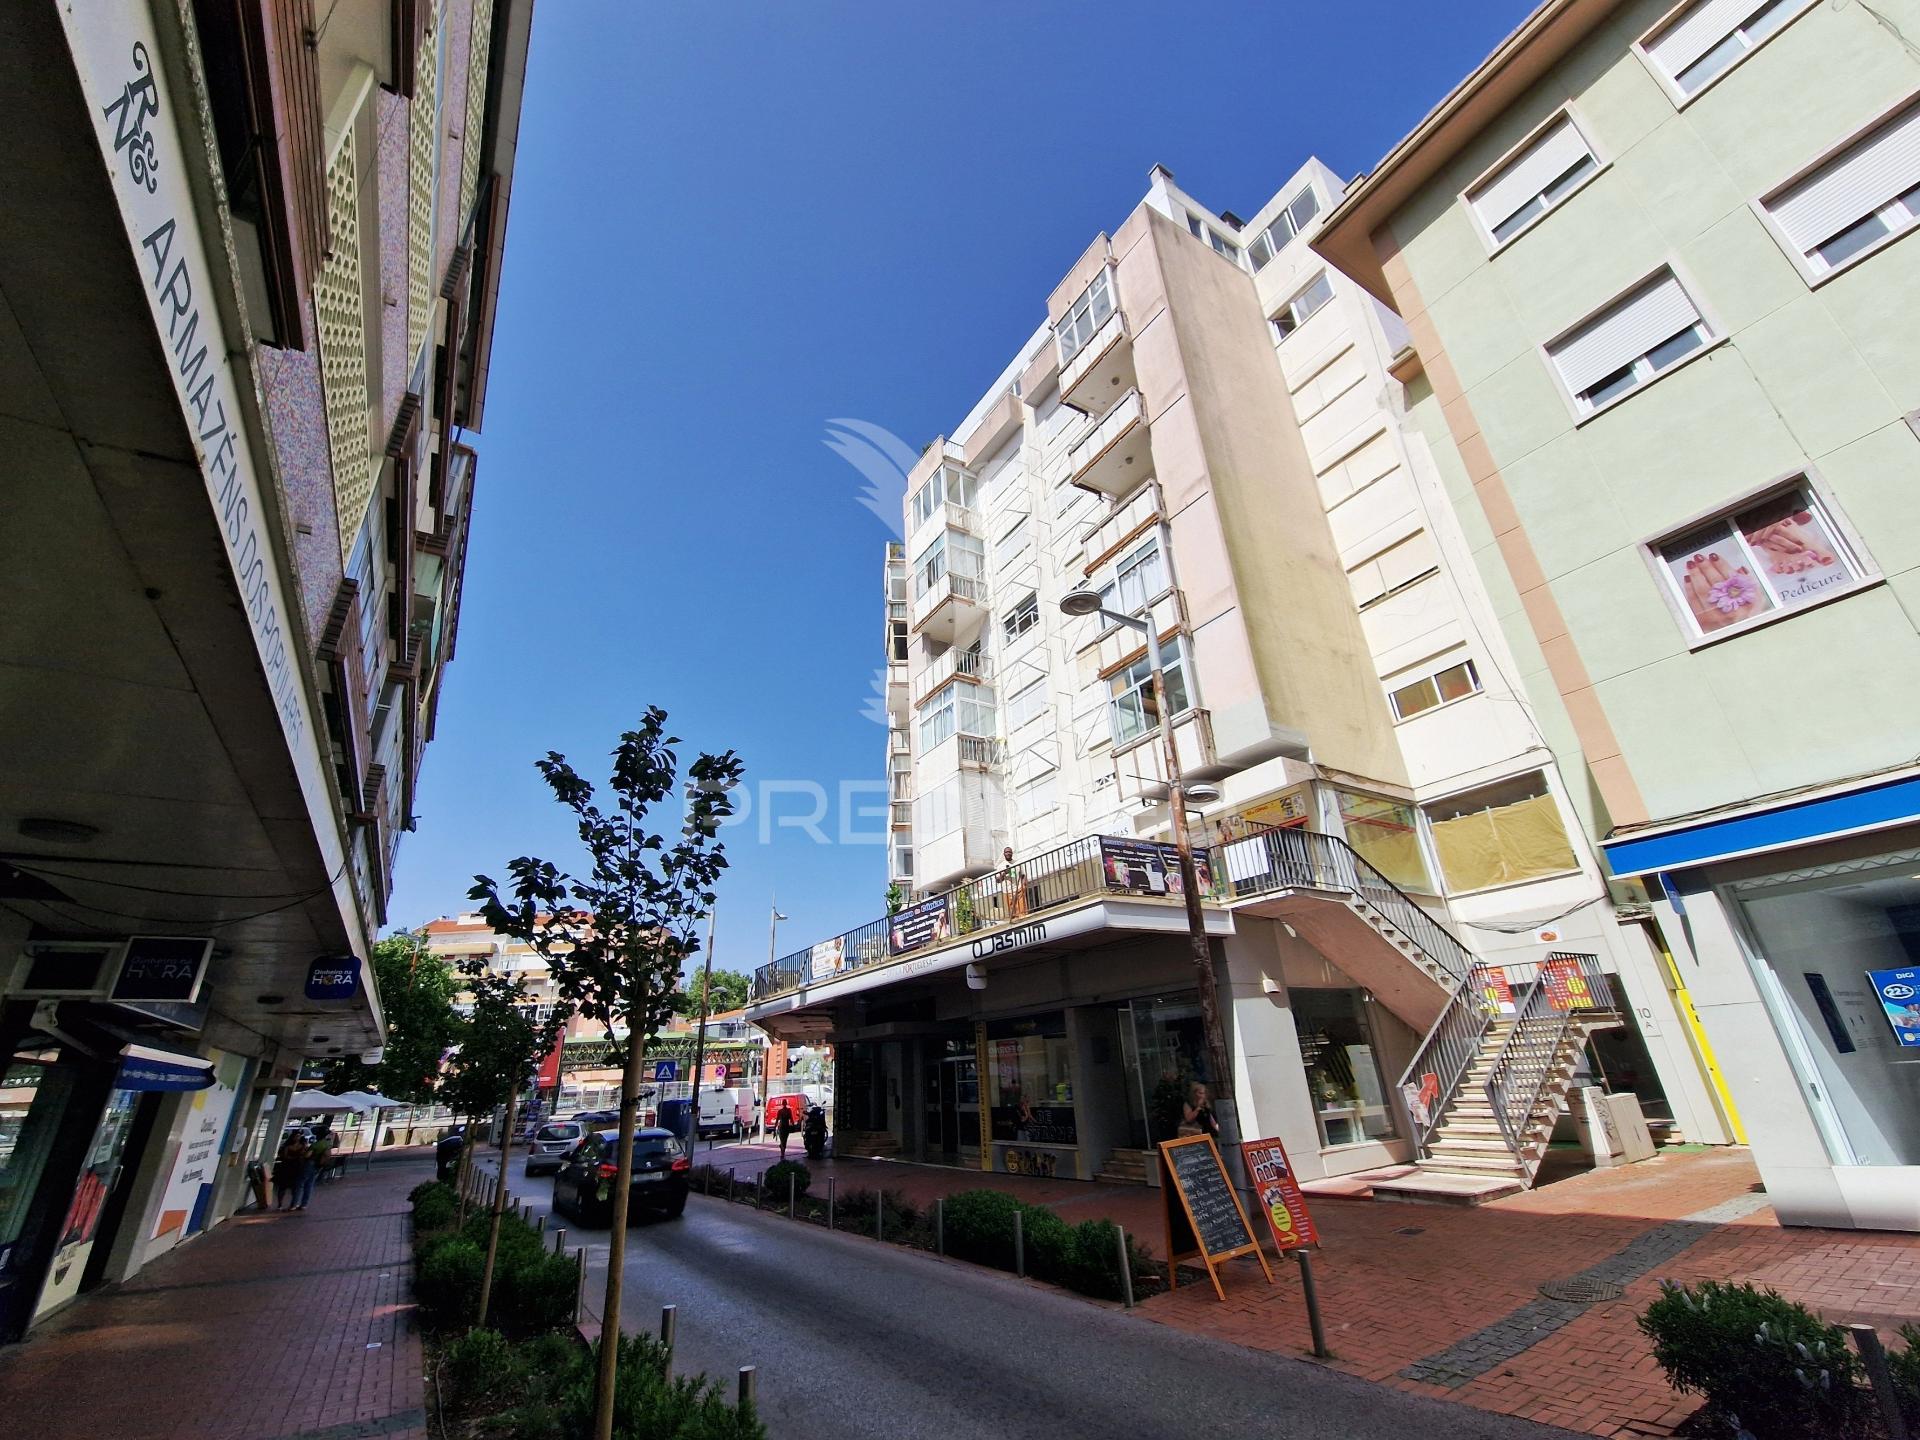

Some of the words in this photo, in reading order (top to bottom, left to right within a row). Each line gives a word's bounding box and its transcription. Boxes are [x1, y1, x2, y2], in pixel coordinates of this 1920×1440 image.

[239, 530, 268, 623] DOS
[1780, 571, 1844, 602] Pedicure
[1895, 972, 1915, 980] DIGI
[1637, 1008, 1651, 1019] 10
[1646, 1021, 1653, 1029] A
